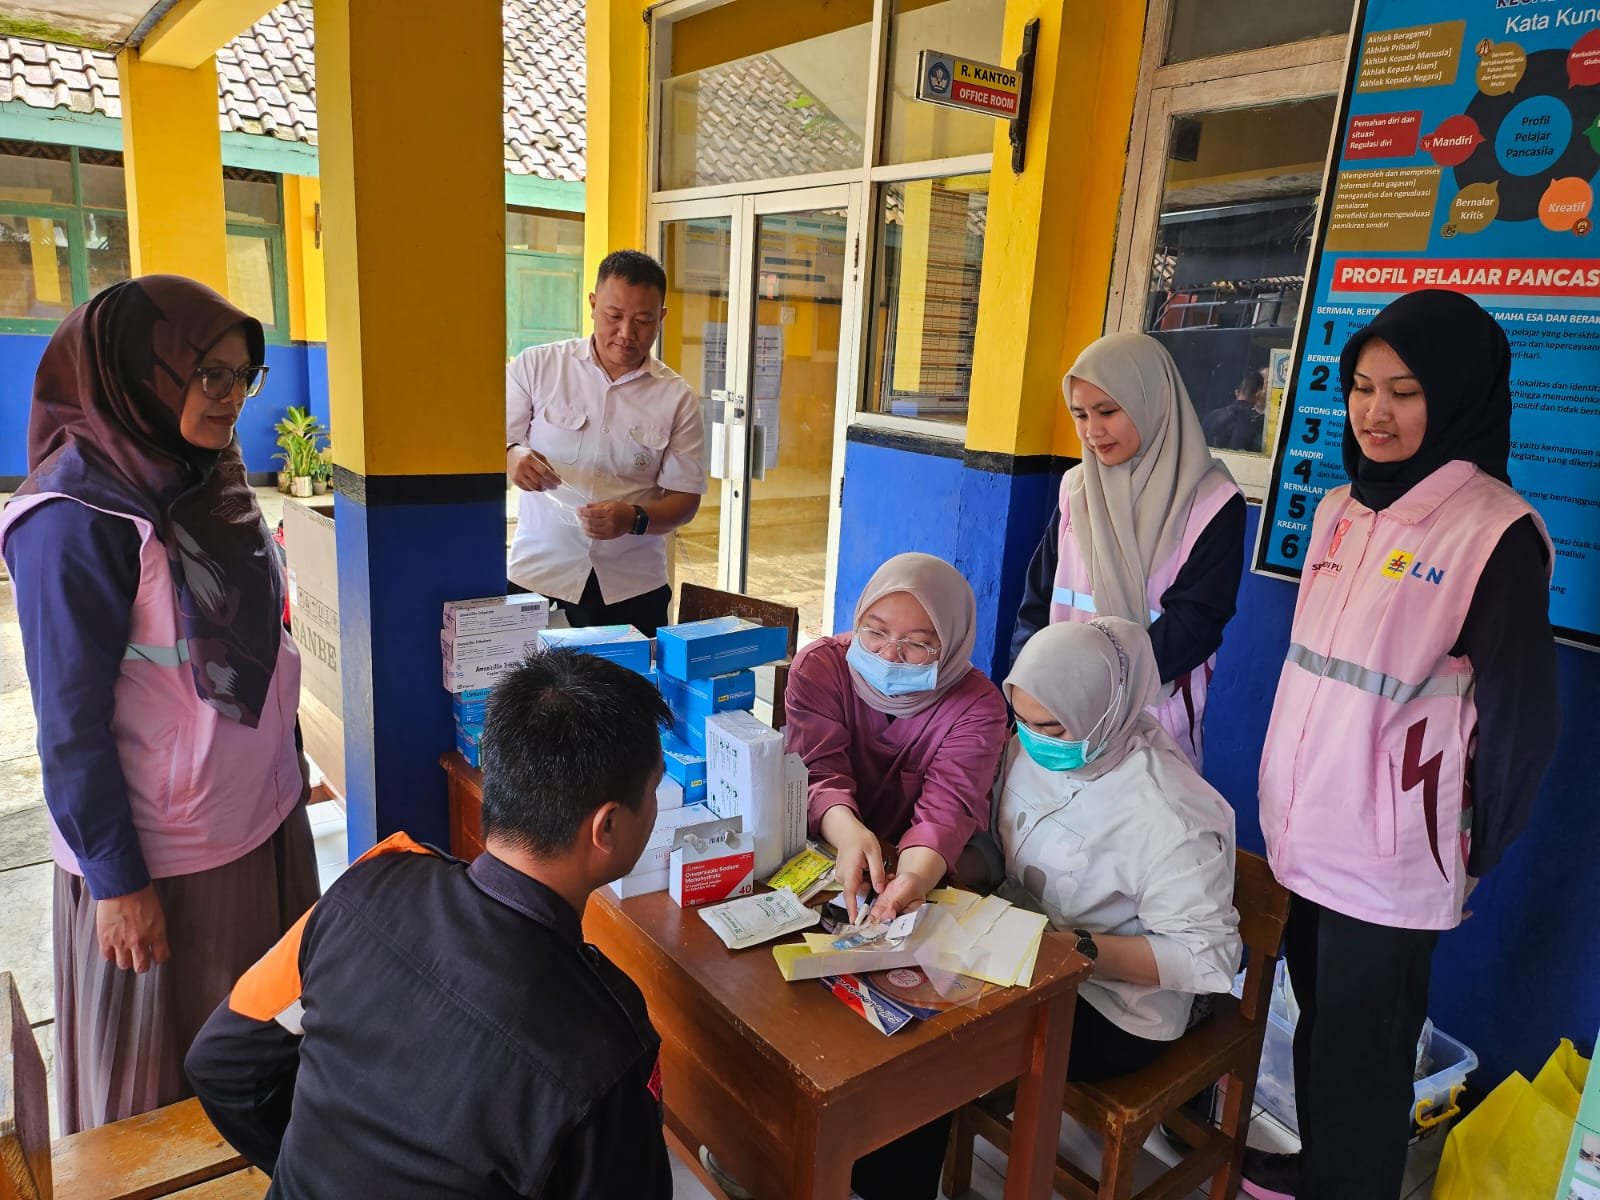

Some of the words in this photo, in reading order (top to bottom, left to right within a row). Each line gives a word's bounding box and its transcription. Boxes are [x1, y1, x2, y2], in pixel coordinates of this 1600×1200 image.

[1505, 13, 1550, 34] Kata
[1368, 34, 1391, 44] Akhlak
[1365, 44, 1390, 55] Akhlak
[1363, 55, 1387, 66] Akhlak
[1388, 53, 1416, 64] Kepada
[961, 65, 971, 78] R.
[974, 67, 1016, 88] KANTOR
[1362, 67, 1386, 77] Akhlak
[1387, 64, 1413, 74] Kepada
[1360, 78, 1384, 87] Akhlak
[1385, 75, 1411, 86] Kepada
[960, 88, 988, 104] OFFICE
[990, 94, 1014, 109] ROOM
[1387, 116, 1400, 125] diri
[1522, 115, 1551, 126] Profil
[1352, 130, 1375, 139] situasi
[1514, 131, 1551, 143] Pelajar
[1350, 140, 1379, 150] Regulasi
[1380, 139, 1392, 147] diri
[1433, 135, 1473, 147] Mandiri
[1506, 146, 1554, 158] Pancasila
[1341, 170, 1384, 180] Memperoleh
[1385, 169, 1398, 177] dan
[1372, 180, 1385, 188] dan
[1336, 203, 1369, 211] penalaran
[1456, 197, 1494, 207] Bernalar
[1548, 201, 1586, 213] Kreatif
[1460, 211, 1484, 220] Kritis
[1341, 267, 1408, 284] PROFIL
[1412, 268, 1502, 286] PELAJAR
[1317, 306, 1355, 316] BERIMAN,
[1357, 308, 1381, 316] BERTA
[1495, 312, 1524, 321] MAHA
[1526, 313, 1543, 322] ESA
[1546, 313, 1567, 323] DAN
[1323, 320, 1334, 346] 1
[1542, 330, 1561, 338] yang
[1309, 365, 1330, 391] 2
[1298, 405, 1331, 416] GOTONG
[1332, 408, 1347, 417] ROY
[1301, 418, 1322, 444] 3
[1289, 449, 1324, 460] MANDIRI
[1293, 459, 1313, 485] 4
[1283, 482, 1323, 495] BERNALAR
[1528, 491, 1548, 500] yang
[1288, 493, 1307, 519] 5
[1277, 519, 1308, 532] KREATIF
[1280, 533, 1300, 559] 6
[292, 615, 337, 672] SANBE
[739, 884, 752, 895] 40
